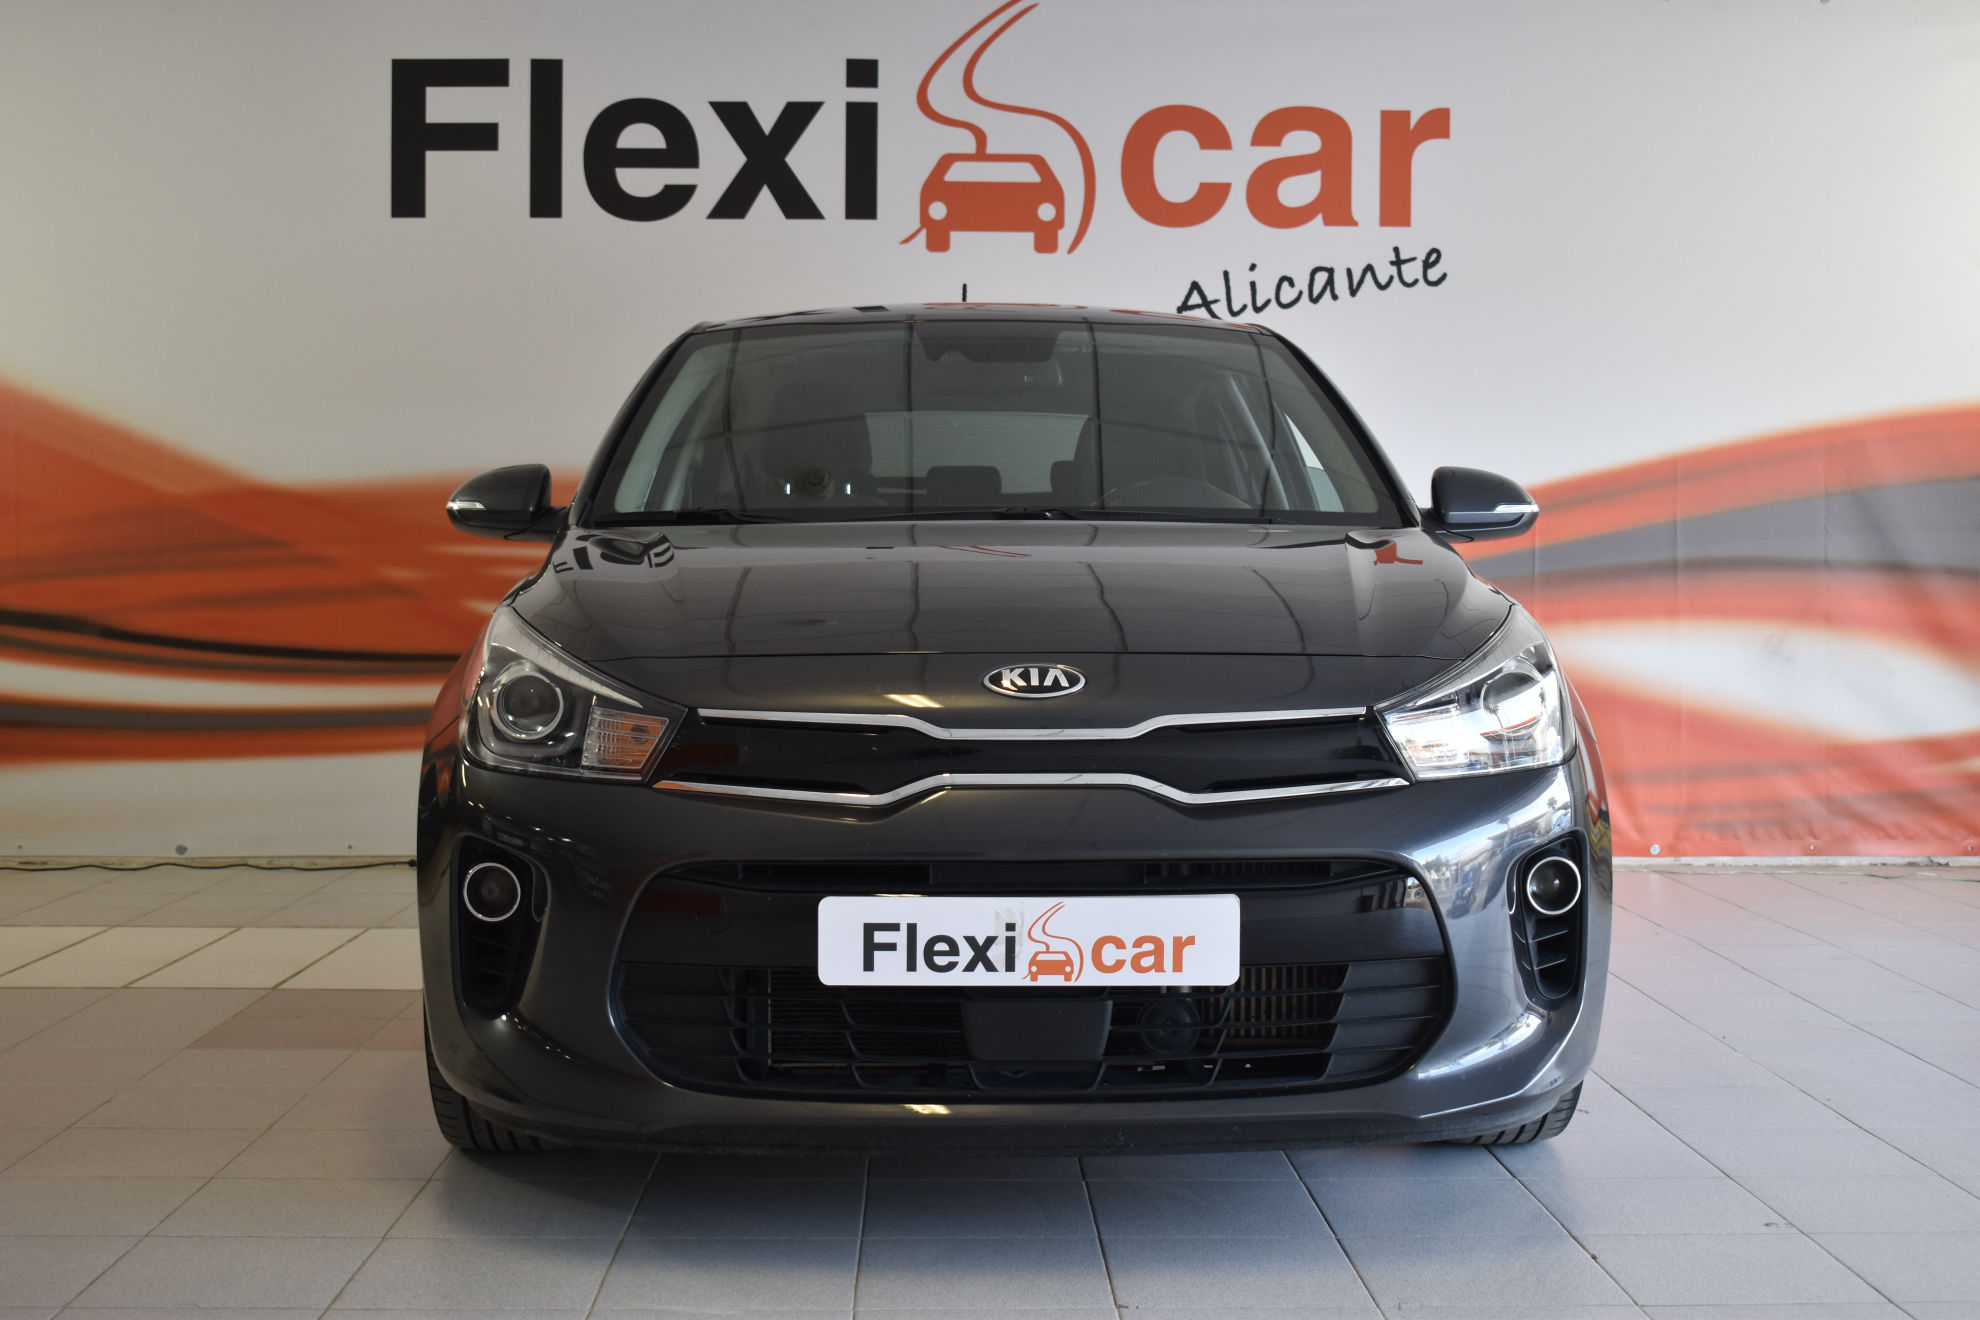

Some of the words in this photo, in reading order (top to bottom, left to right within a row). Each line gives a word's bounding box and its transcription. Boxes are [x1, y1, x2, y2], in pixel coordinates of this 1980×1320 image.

[390, 58, 879, 223] Flexi
[1120, 104, 1451, 229] car
[1176, 246, 1448, 320] Alicante
[1000, 667, 1070, 691] KIA
[862, 922, 1017, 974] Flexi
[1090, 934, 1196, 974] car
